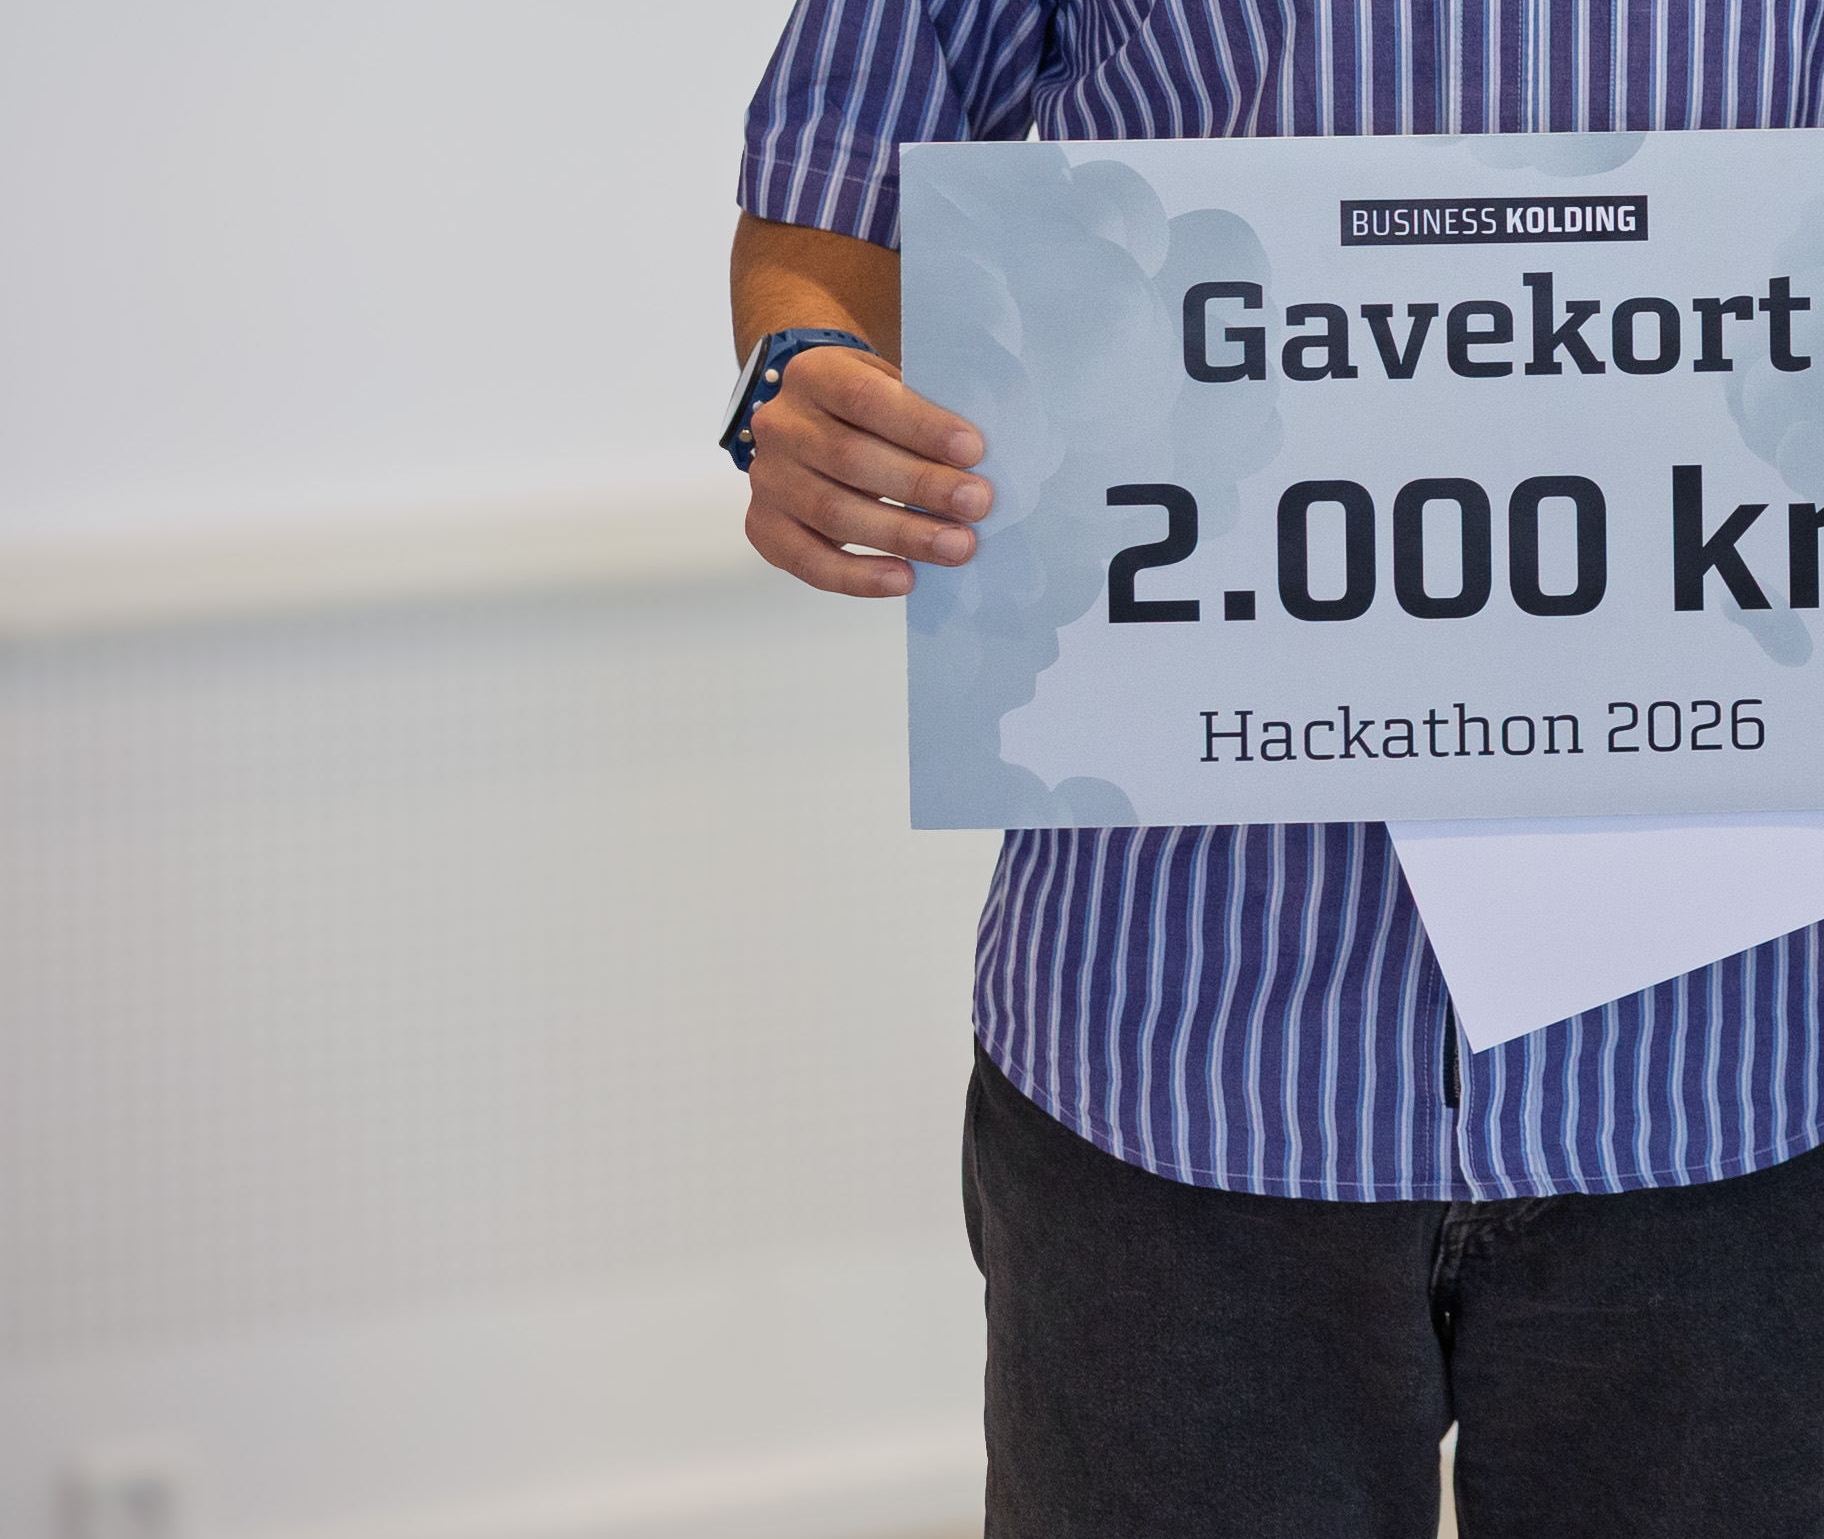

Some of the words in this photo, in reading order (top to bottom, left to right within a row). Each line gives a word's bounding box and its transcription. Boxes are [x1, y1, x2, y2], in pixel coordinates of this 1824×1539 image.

[1352, 207, 1497, 236] BUSINESS
[1506, 205, 1636, 234] KOLDING
[1182, 271, 1812, 384] Gavekort
[1106, 474, 1608, 624] 2.000
[1199, 702, 1584, 763] Hackathon
[1606, 697, 1766, 754] 2026
